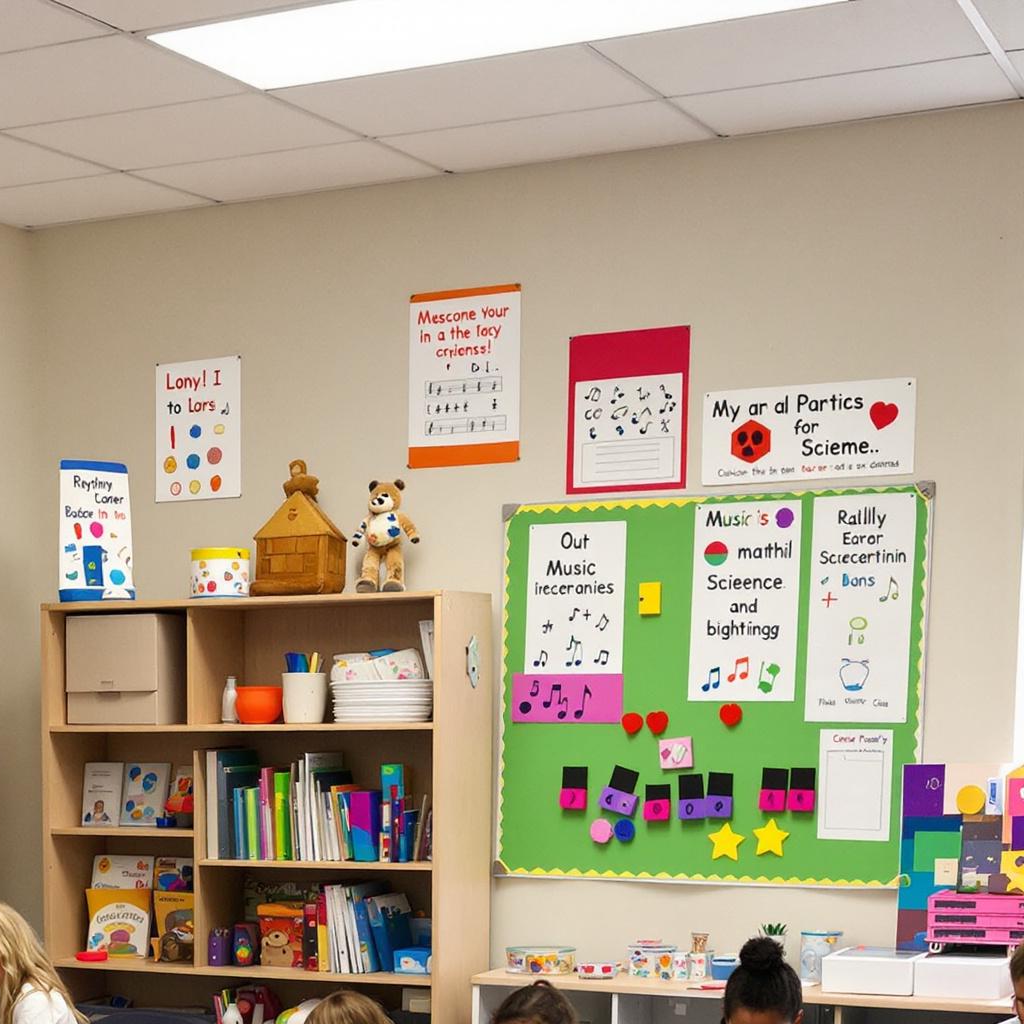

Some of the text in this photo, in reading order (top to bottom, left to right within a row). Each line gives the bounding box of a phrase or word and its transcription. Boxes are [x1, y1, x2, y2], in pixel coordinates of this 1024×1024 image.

[450, 325, 471, 340] the
[166, 369, 222, 391] Lony! I
[167, 401, 182, 415] to
[712, 399, 740, 423] My
[748, 402, 768, 417] ar
[797, 393, 864, 413] Partics
[794, 418, 819, 436] for
[705, 510, 752, 527] Music
[561, 531, 590, 550] Out
[546, 559, 596, 576] Music
[729, 598, 758, 614] and
